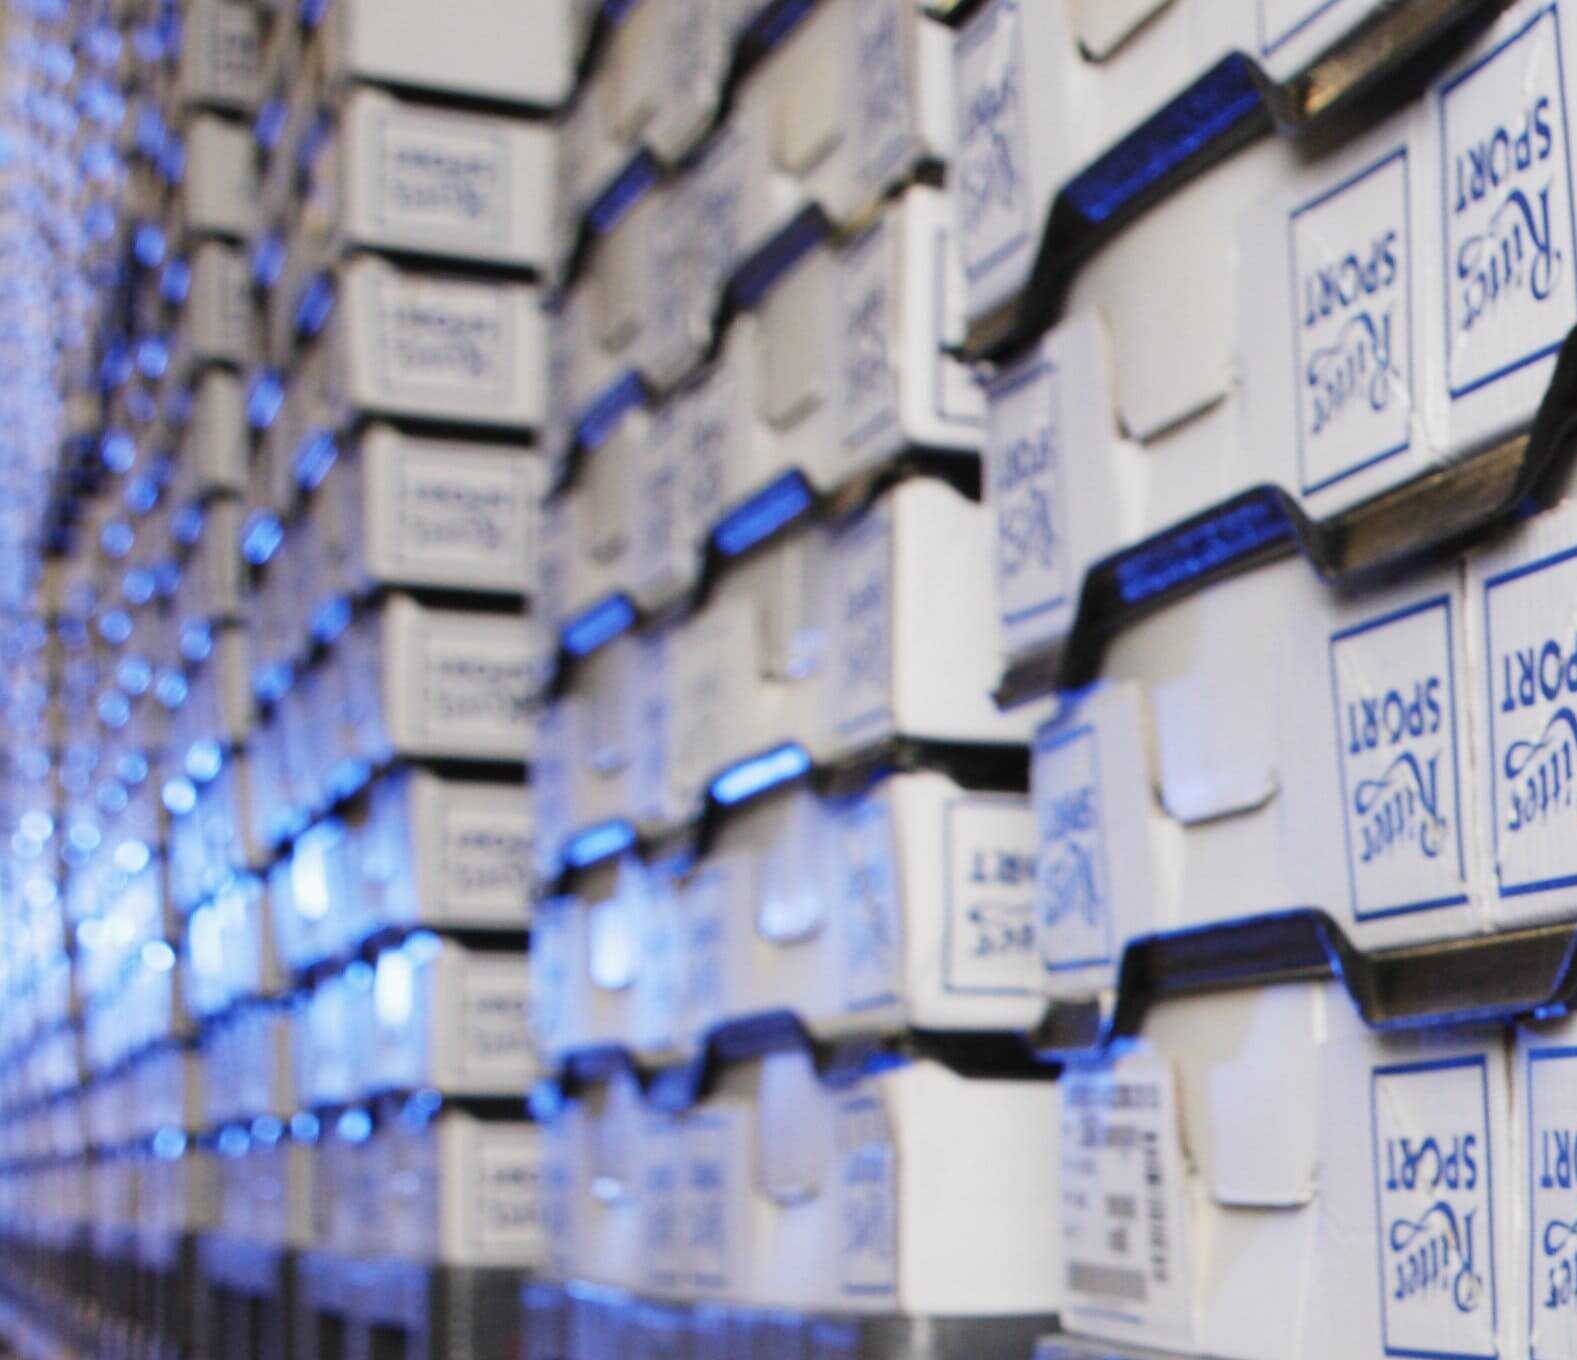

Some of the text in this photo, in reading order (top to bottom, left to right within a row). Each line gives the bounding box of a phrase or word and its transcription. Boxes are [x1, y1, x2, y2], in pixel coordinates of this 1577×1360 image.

[1453, 95, 1553, 214] SPORT
[1304, 228, 1397, 330] SPORT
[1347, 674, 1442, 757] SPORT
[1384, 1131, 1478, 1193] SPORT
[1388, 1198, 1483, 1314] Ritter
